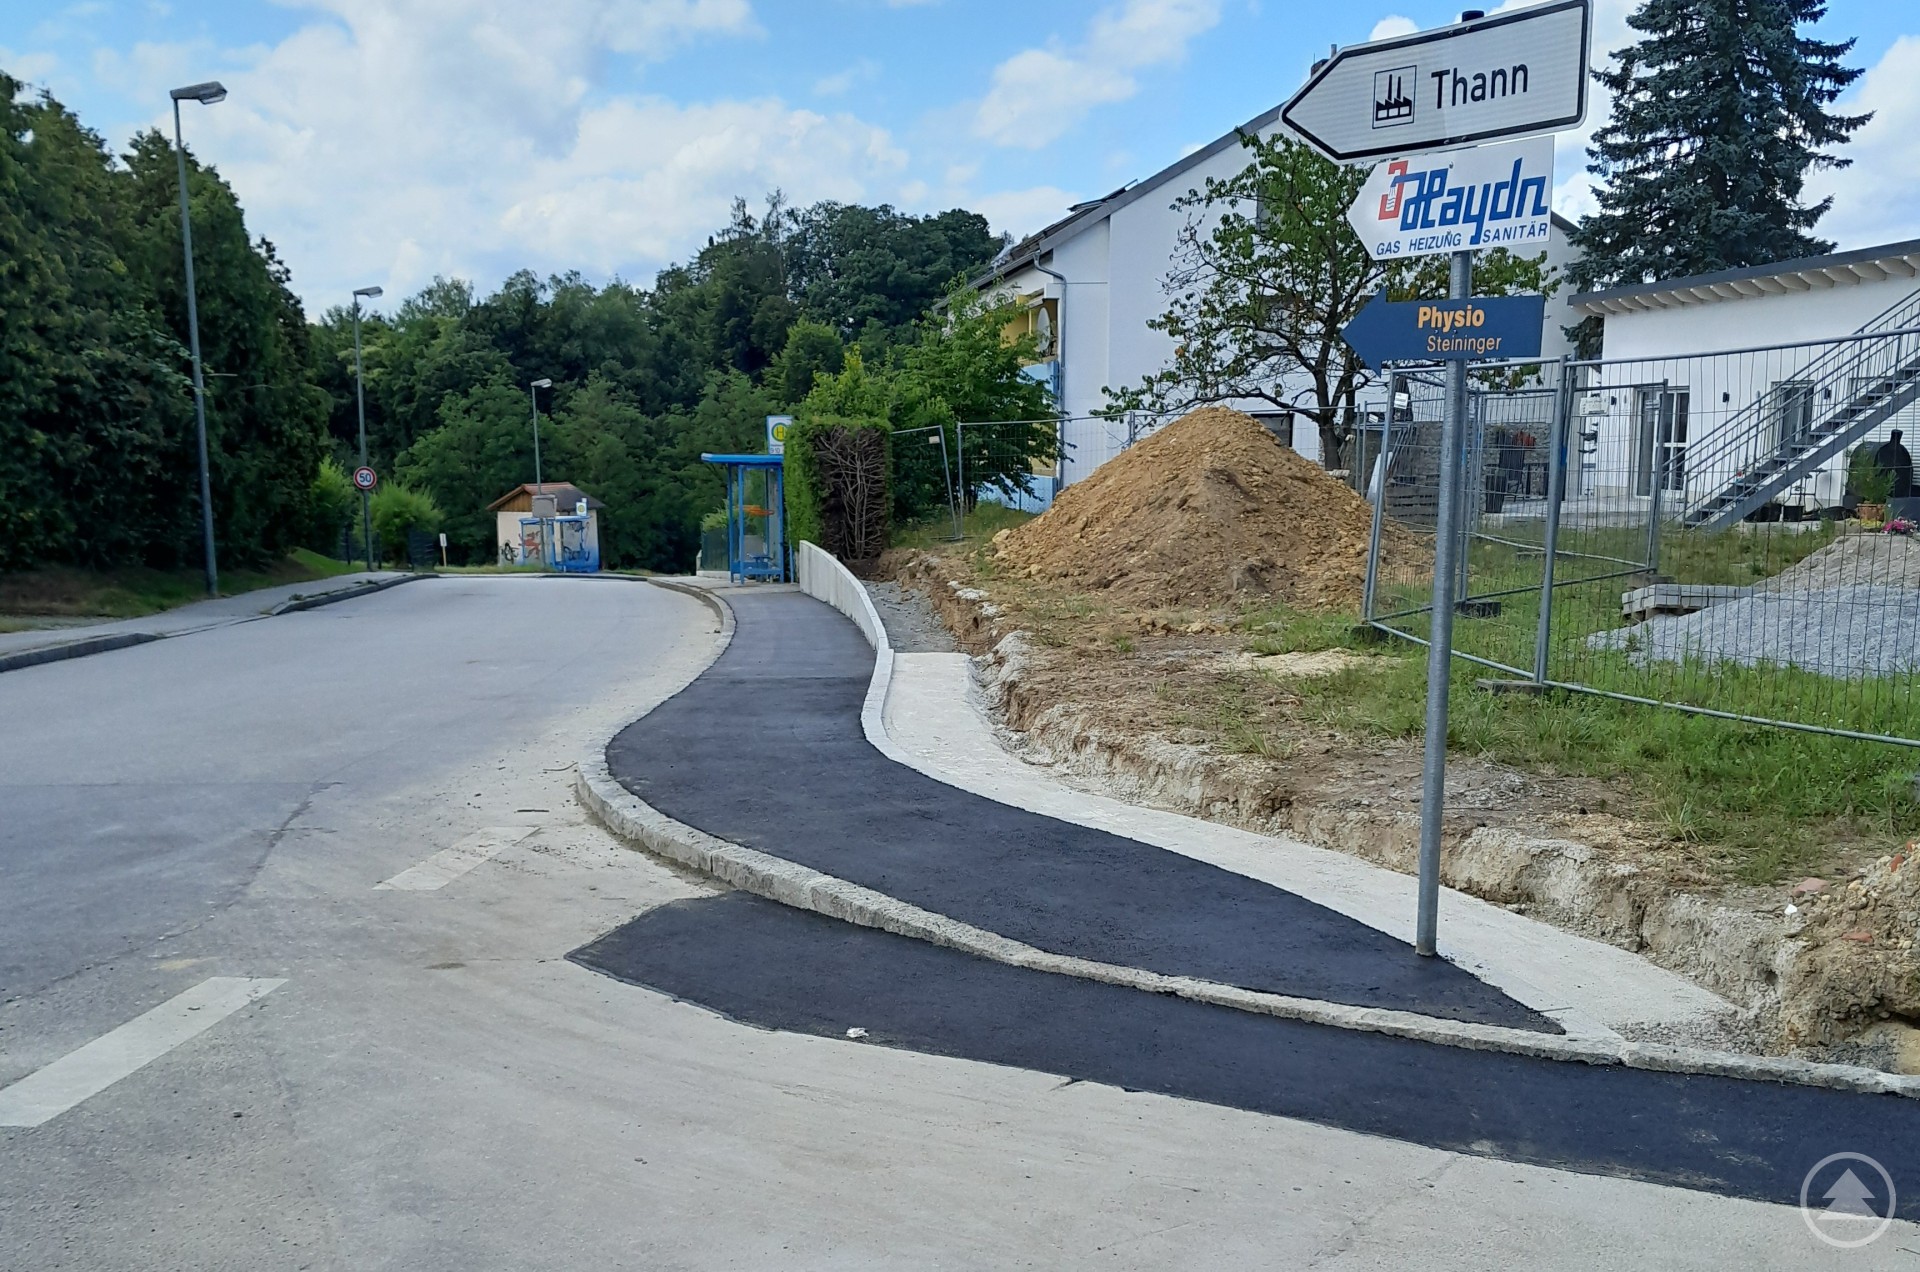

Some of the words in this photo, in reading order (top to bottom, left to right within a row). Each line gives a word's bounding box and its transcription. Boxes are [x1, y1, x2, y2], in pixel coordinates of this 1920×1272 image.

[1431, 63, 1528, 109] Thann
[1376, 240, 1401, 256] GAS
[1408, 233, 1462, 252] HEIZUNG
[1482, 221, 1548, 243] SANITÄR
[1417, 304, 1485, 333] Physio
[1426, 335, 1502, 354] Steininger
[359, 473, 371, 482] 50
